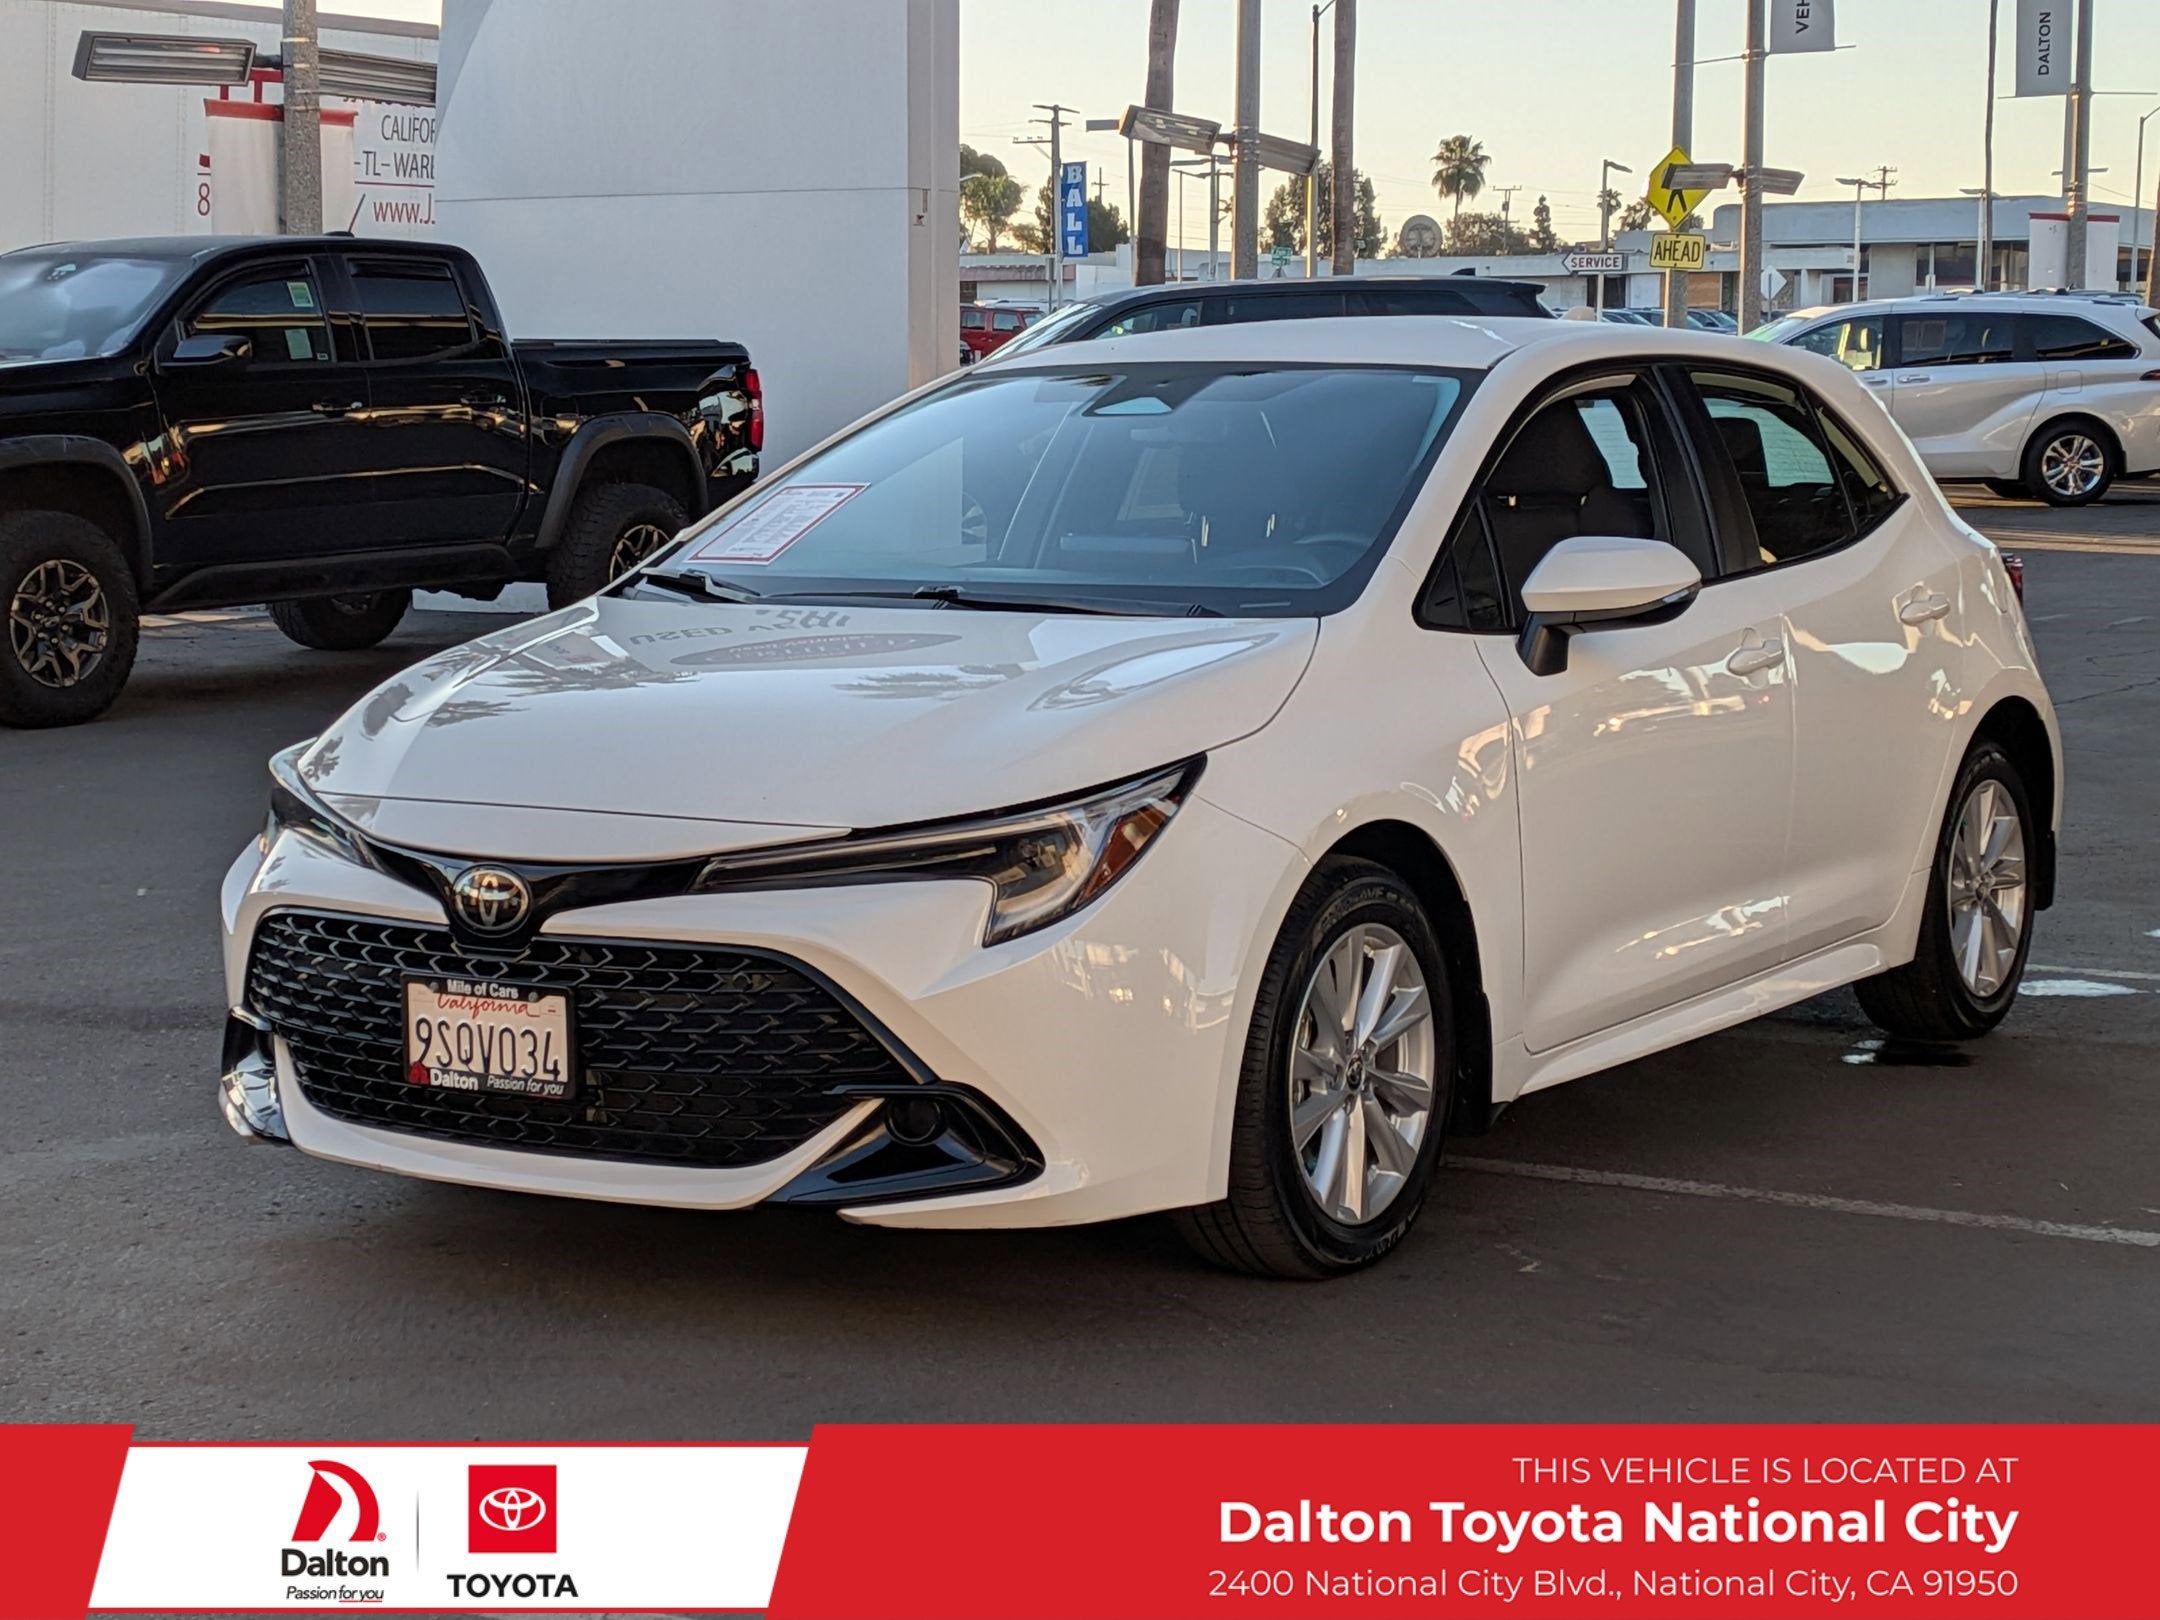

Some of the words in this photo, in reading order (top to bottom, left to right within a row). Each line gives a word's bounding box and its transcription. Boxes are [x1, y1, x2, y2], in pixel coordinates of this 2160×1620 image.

[2037, 11, 2052, 76] DALTON
[1066, 165, 1084, 255] BALL
[1571, 256, 1620, 269] SERVICE
[1653, 240, 1701, 263] AHEAD
[446, 979, 472, 994] Mile
[473, 982, 487, 996] of
[488, 984, 519, 1000] Cars
[415, 1017, 561, 1082] 9SQV034
[429, 1069, 479, 1091] Dalton
[486, 1075, 525, 1092] Passion
[526, 1078, 541, 1093] for
[543, 1084, 565, 1096] you
